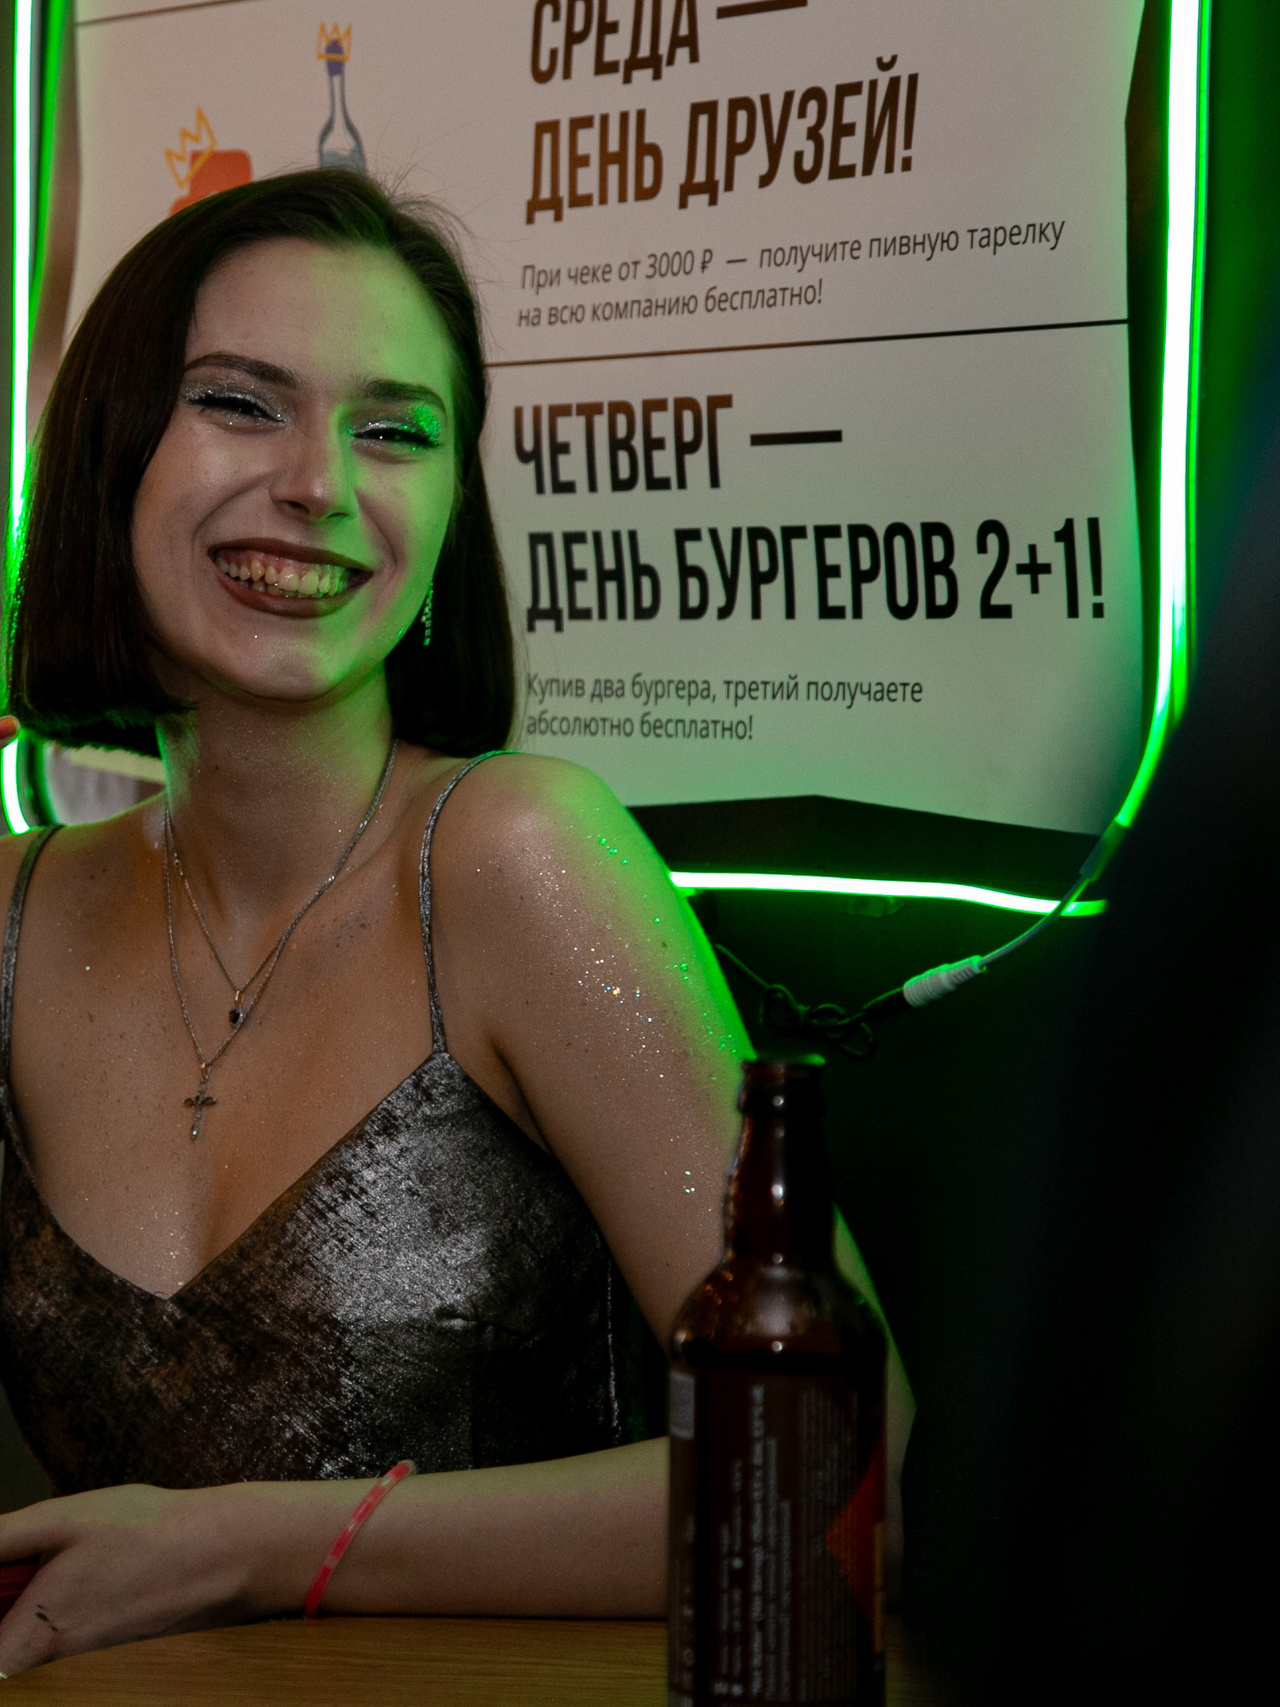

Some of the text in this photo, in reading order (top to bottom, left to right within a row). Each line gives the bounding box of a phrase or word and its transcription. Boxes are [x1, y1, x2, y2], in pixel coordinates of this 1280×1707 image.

[530, 0, 700, 85] СРЕДА
[525, 53, 920, 226] ДЕНЬ ДРУЗЕЙ!
[521, 263, 561, 295] При
[568, 262, 613, 285] чеке
[618, 259, 641, 281] от
[645, 249, 695, 279] 3000
[758, 239, 862, 273] получите
[868, 229, 960, 262] пивную
[966, 220, 1066, 256] тарелку
[518, 278, 823, 327] на всю компанию бесплатно!
[513, 393, 734, 496] ЧЕТВЕРГ
[525, 516, 1106, 634] ДЕНЬ БУРГЕРОВ 2+1!
[526, 672, 924, 710] Купив два бургера, третий получаете
[526, 709, 753, 741] абсолютно бесплатно!
